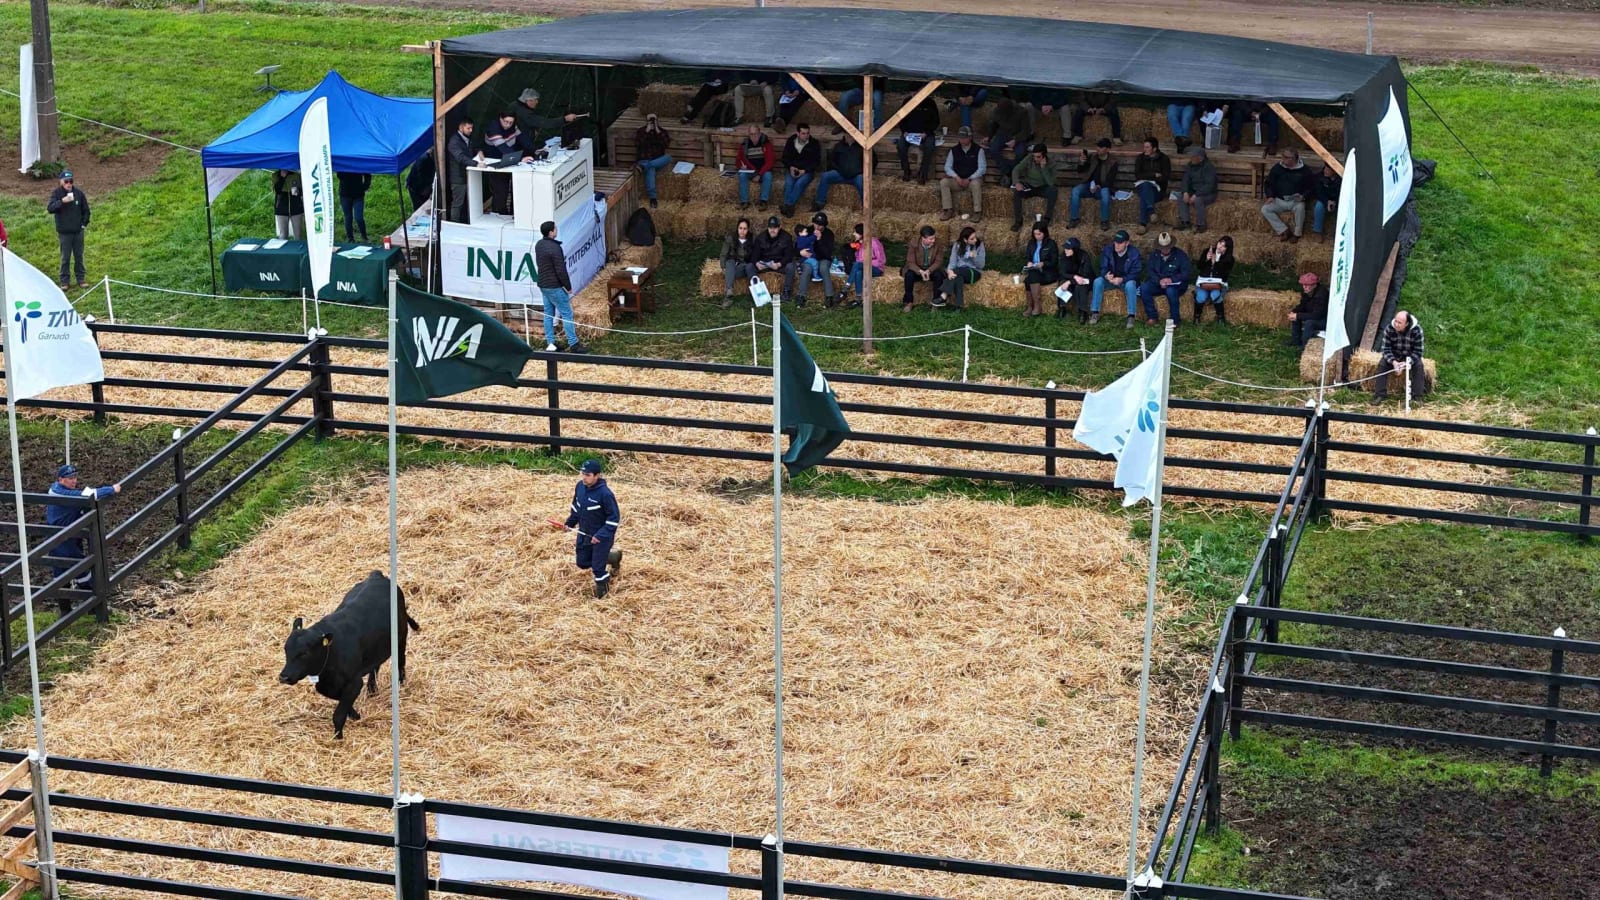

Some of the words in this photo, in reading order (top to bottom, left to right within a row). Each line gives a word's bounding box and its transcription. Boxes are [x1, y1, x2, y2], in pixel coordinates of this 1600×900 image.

[311, 164, 323, 213] INIA
[568, 228, 602, 268] TATTERSALL
[466, 247, 538, 282] INIA
[259, 272, 280, 282] INIA
[336, 281, 358, 293] INIA
[38, 331, 70, 341] Ganado
